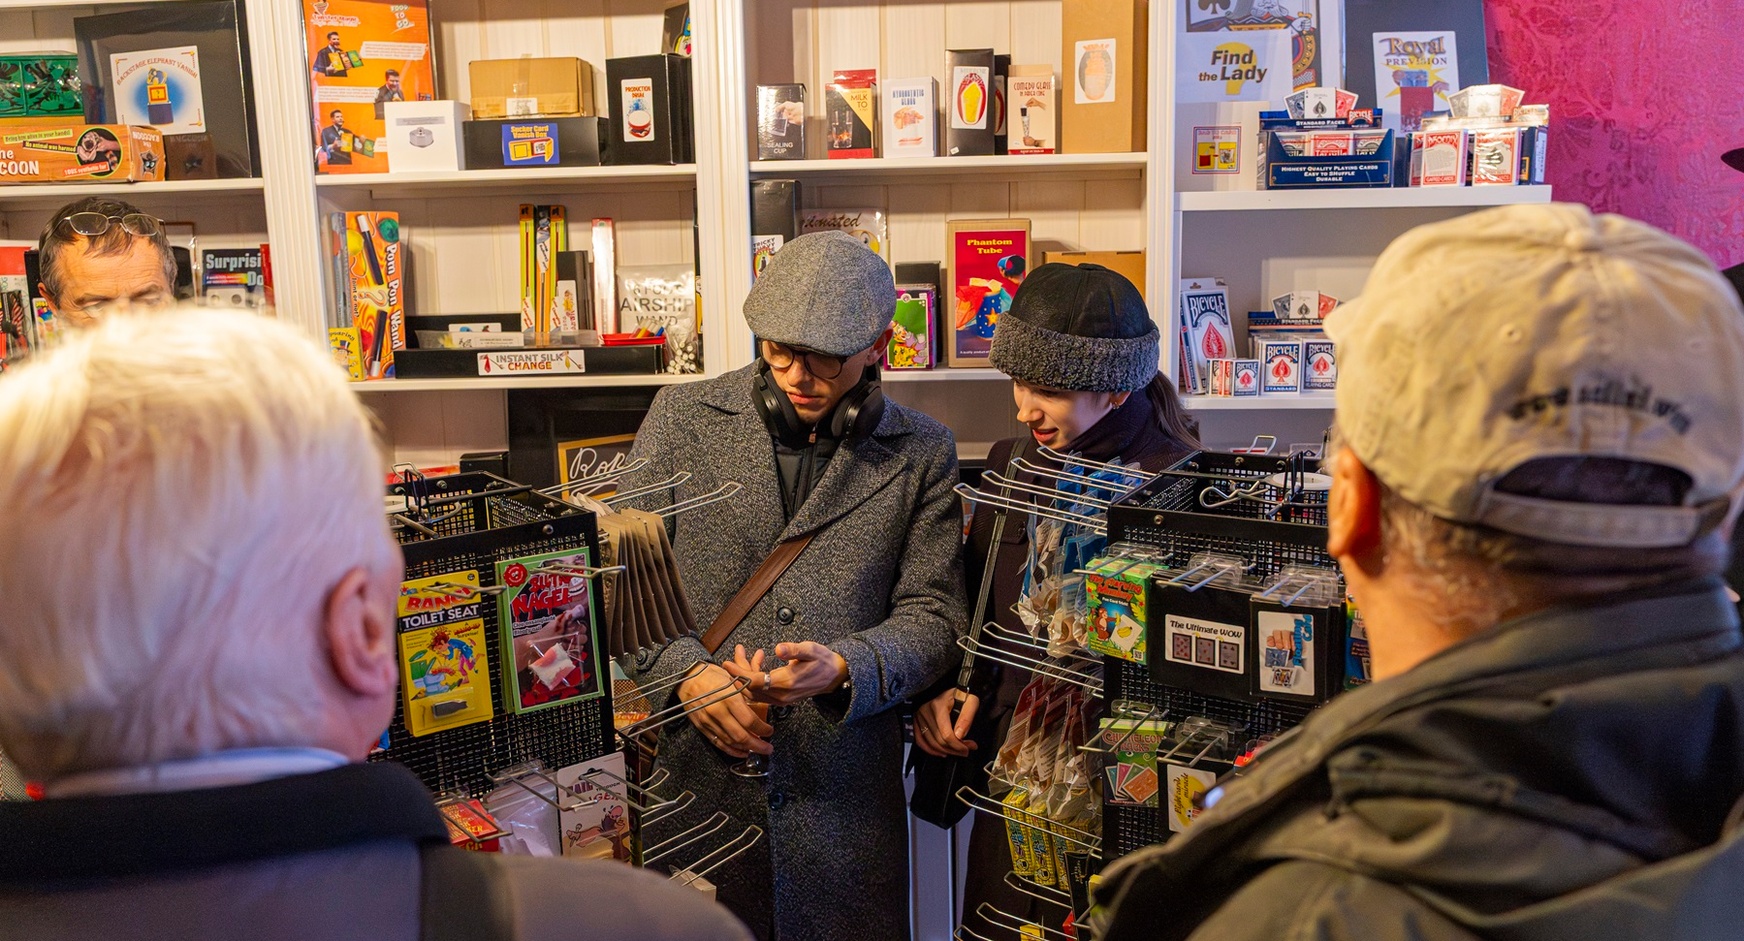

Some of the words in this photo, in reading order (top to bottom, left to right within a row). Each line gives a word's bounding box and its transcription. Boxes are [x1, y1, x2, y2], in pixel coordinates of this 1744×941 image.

[1379, 36, 1446, 58] Royal
[1211, 49, 1254, 65] Find
[1386, 57, 1447, 65] PREVISION
[116, 61, 146, 85] BACKSTAGE
[147, 57, 176, 66] ELEPHANT
[177, 62, 198, 79] VANISH
[1199, 72, 1218, 81] the
[1220, 65, 1267, 83] Lady
[1014, 81, 1035, 90] COMEDY
[1349, 110, 1372, 123] BICYCLE
[753, 237, 775, 247] TRICKY
[206, 253, 262, 271] Surprisi
[386, 244, 397, 275] Pom
[388, 279, 399, 306] Pon
[621, 297, 693, 312] AIRSHIP
[1189, 295, 1227, 326] BICYCLE
[390, 310, 403, 349] Wand
[496, 354, 538, 363] INSTANT
[541, 353, 563, 362] SILK
[1267, 345, 1298, 362] BICYCLE
[508, 362, 552, 371] CHANGE
[512, 588, 572, 617] NAGEL
[403, 611, 445, 628] TOILET
[447, 605, 479, 620] SEAT
[1170, 620, 1184, 629] The
[1186, 623, 1218, 635] Ultimate
[1220, 628, 1242, 638] WOW
[1293, 619, 1302, 667] Floating
